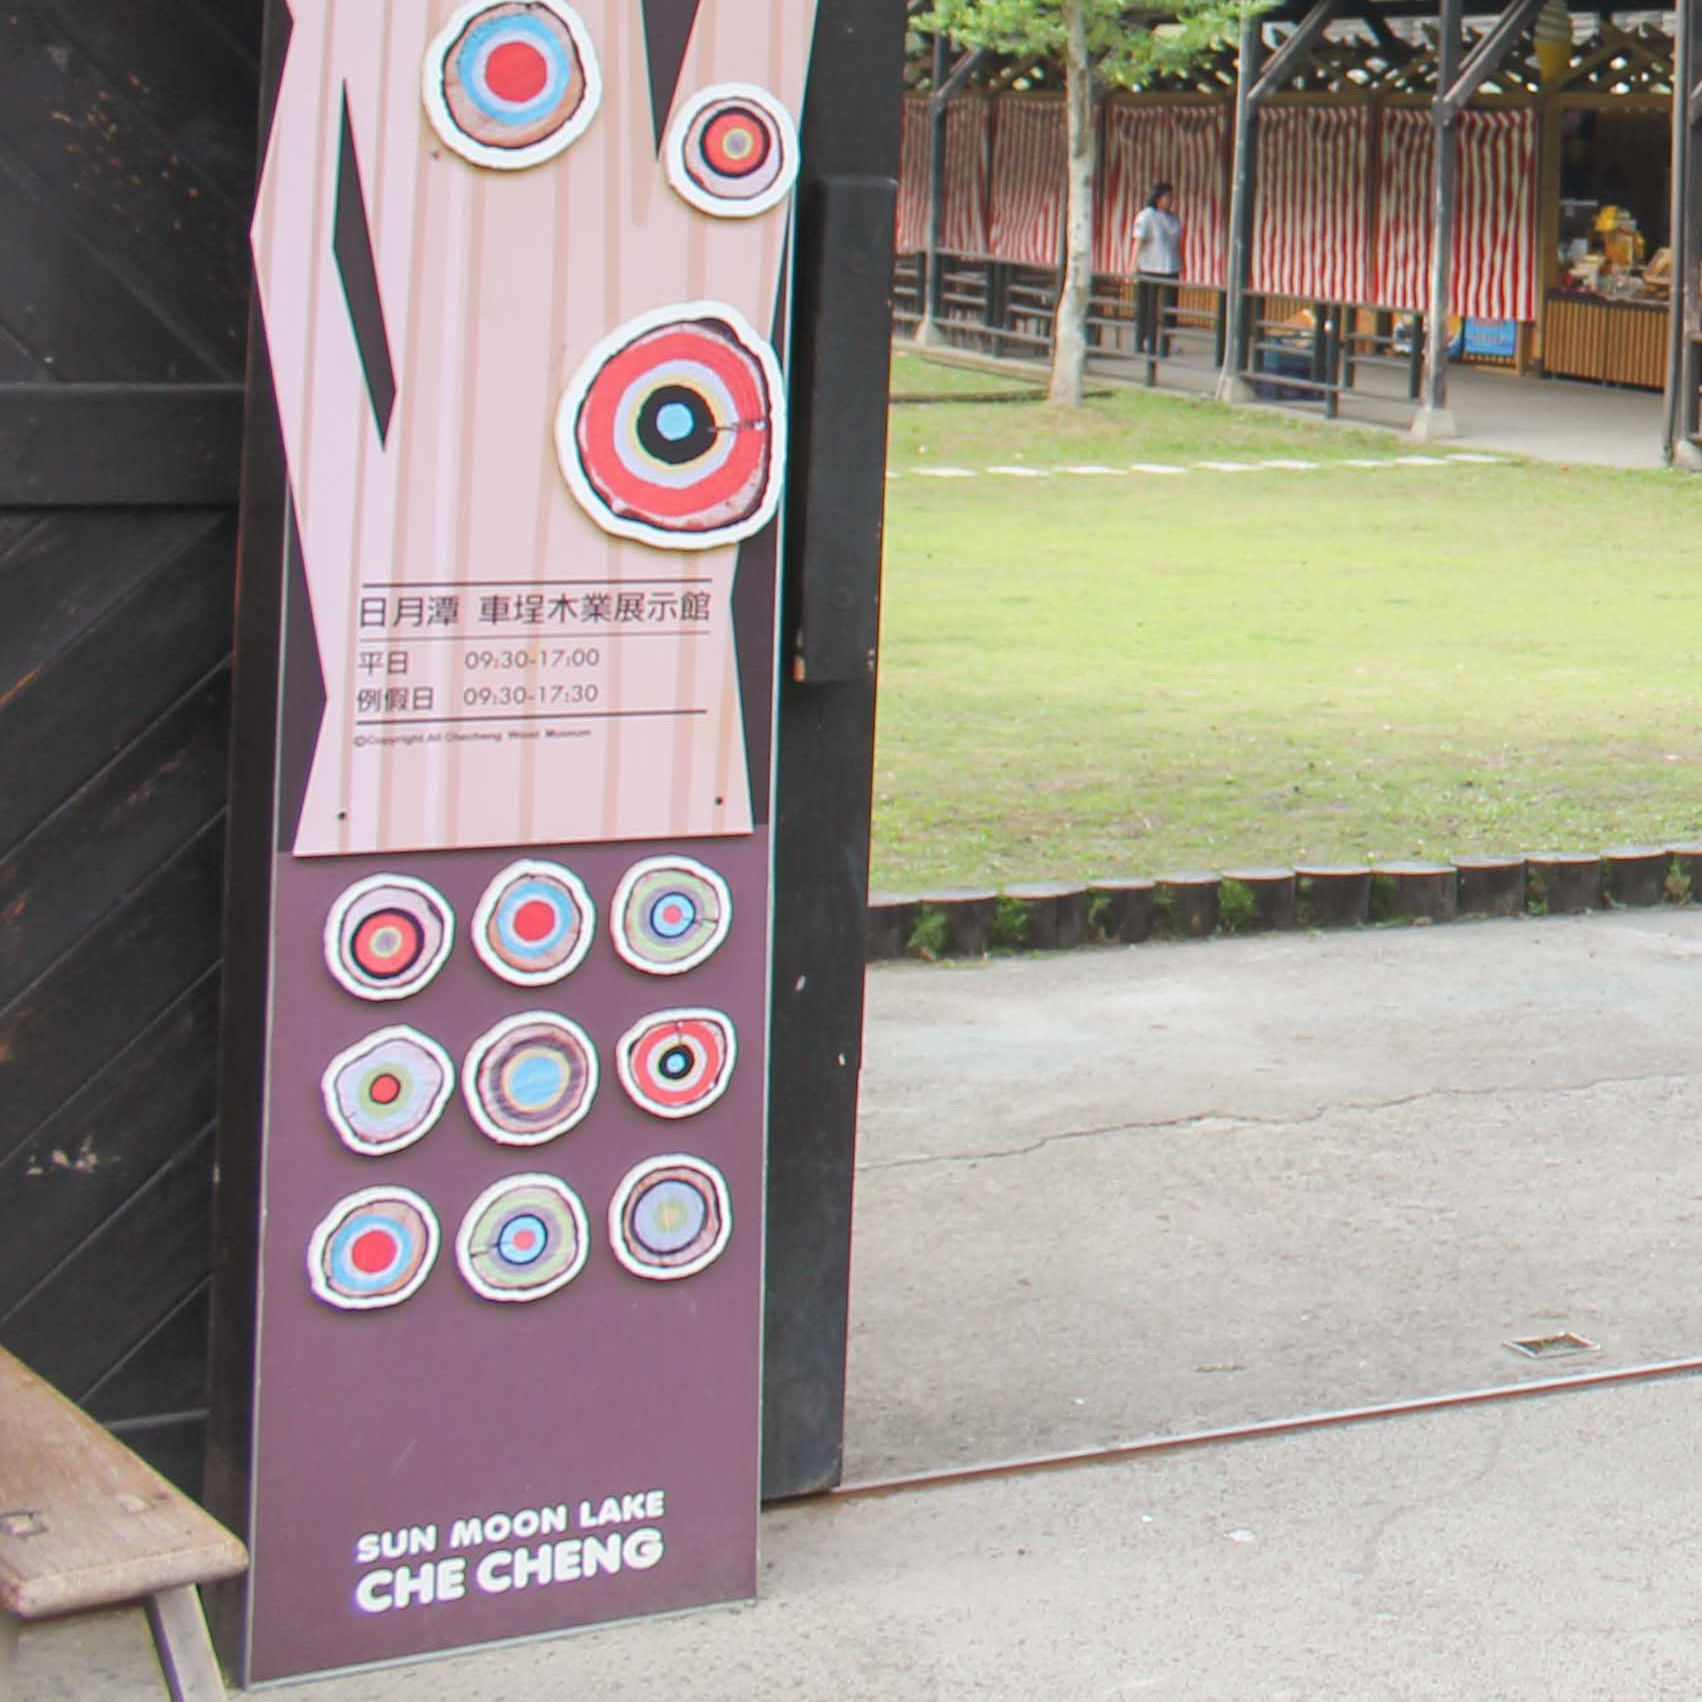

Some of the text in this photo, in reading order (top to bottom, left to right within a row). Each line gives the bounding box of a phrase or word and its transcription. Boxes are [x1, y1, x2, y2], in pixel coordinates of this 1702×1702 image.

[360, 591, 711, 627] 日月潭 車埕木業展示館
[358, 648, 600, 676] 平日 09:30-17:00
[357, 685, 599, 713] 例假日 09:30-17:30
[355, 1490, 665, 1563] SUN MOON LAKE
[355, 1528, 664, 1613] CHE CHENG
